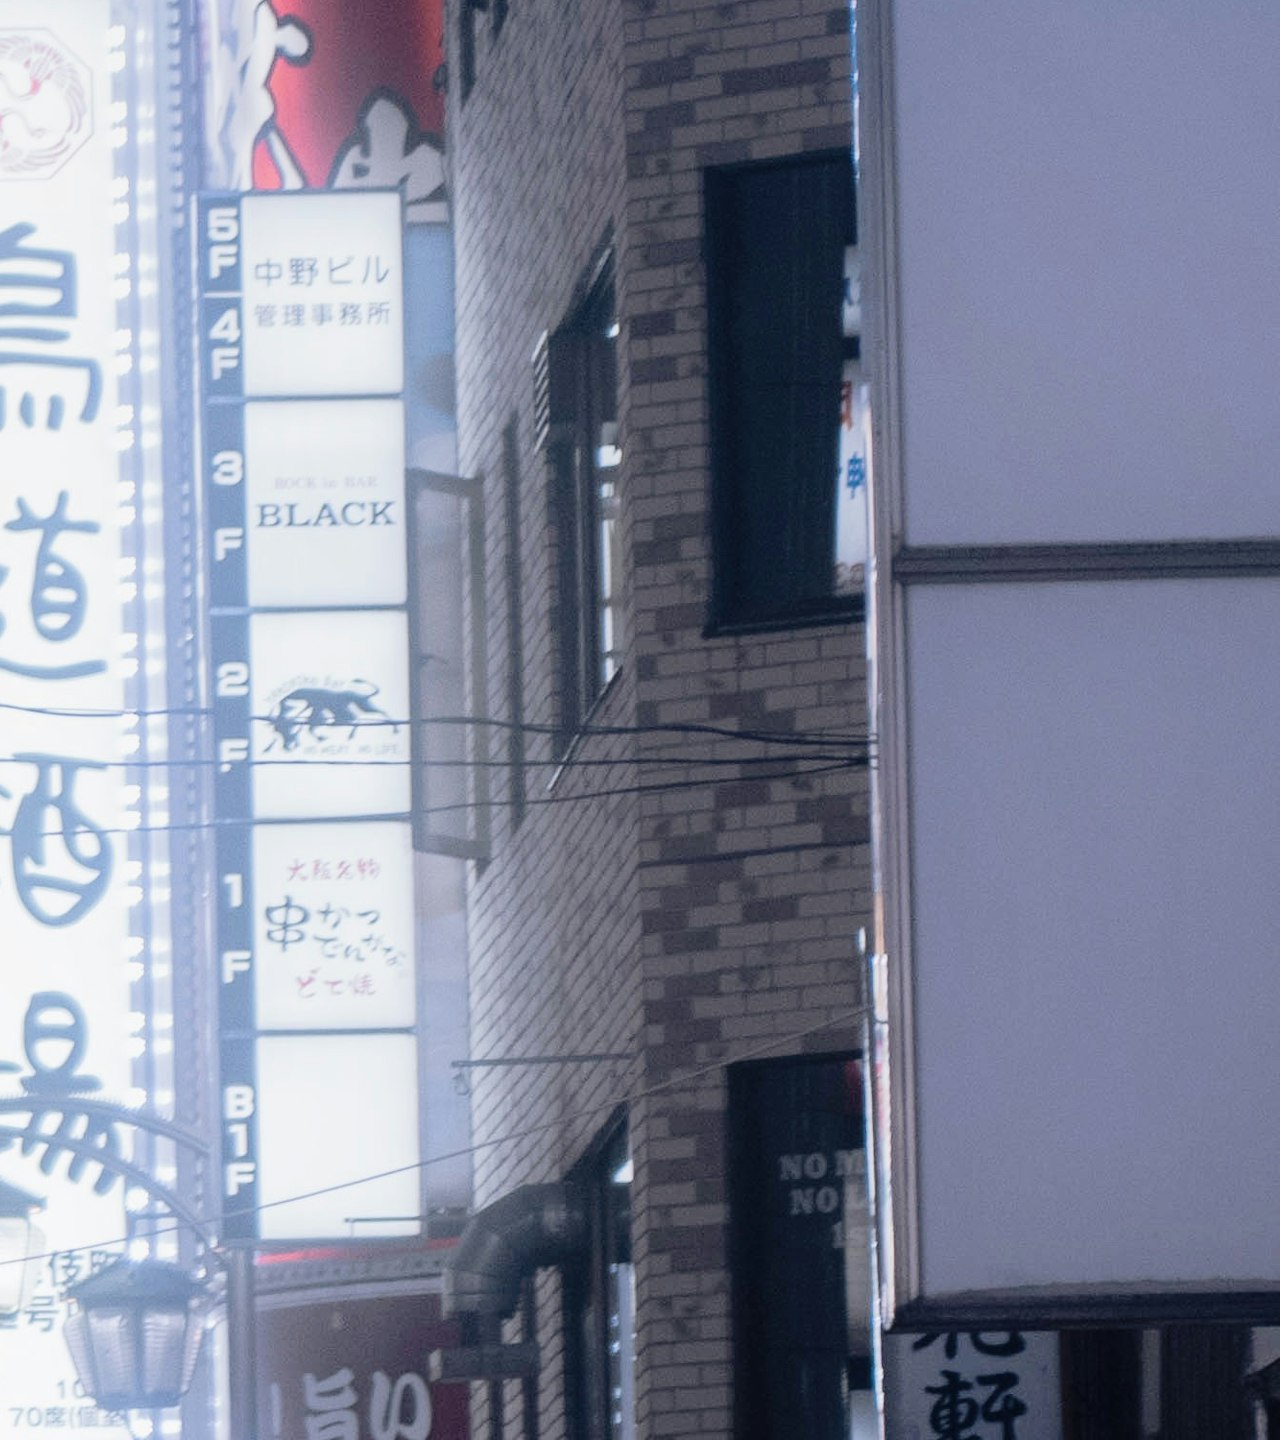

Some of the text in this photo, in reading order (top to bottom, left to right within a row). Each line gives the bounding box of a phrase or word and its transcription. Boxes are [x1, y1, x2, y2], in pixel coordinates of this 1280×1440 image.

[207, 207, 239, 280] 5F
[253, 256, 390, 288] 中野ビル
[210, 308, 241, 380] 4F
[253, 302, 391, 328] 管理事務所
[212, 450, 244, 561] 3F
[255, 501, 397, 529] BLACK
[286, 857, 382, 884] 大阪名物
[223, 872, 252, 985] 1F
[265, 895, 380, 954] 串かつ
[225, 1085, 256, 1197] B1F
